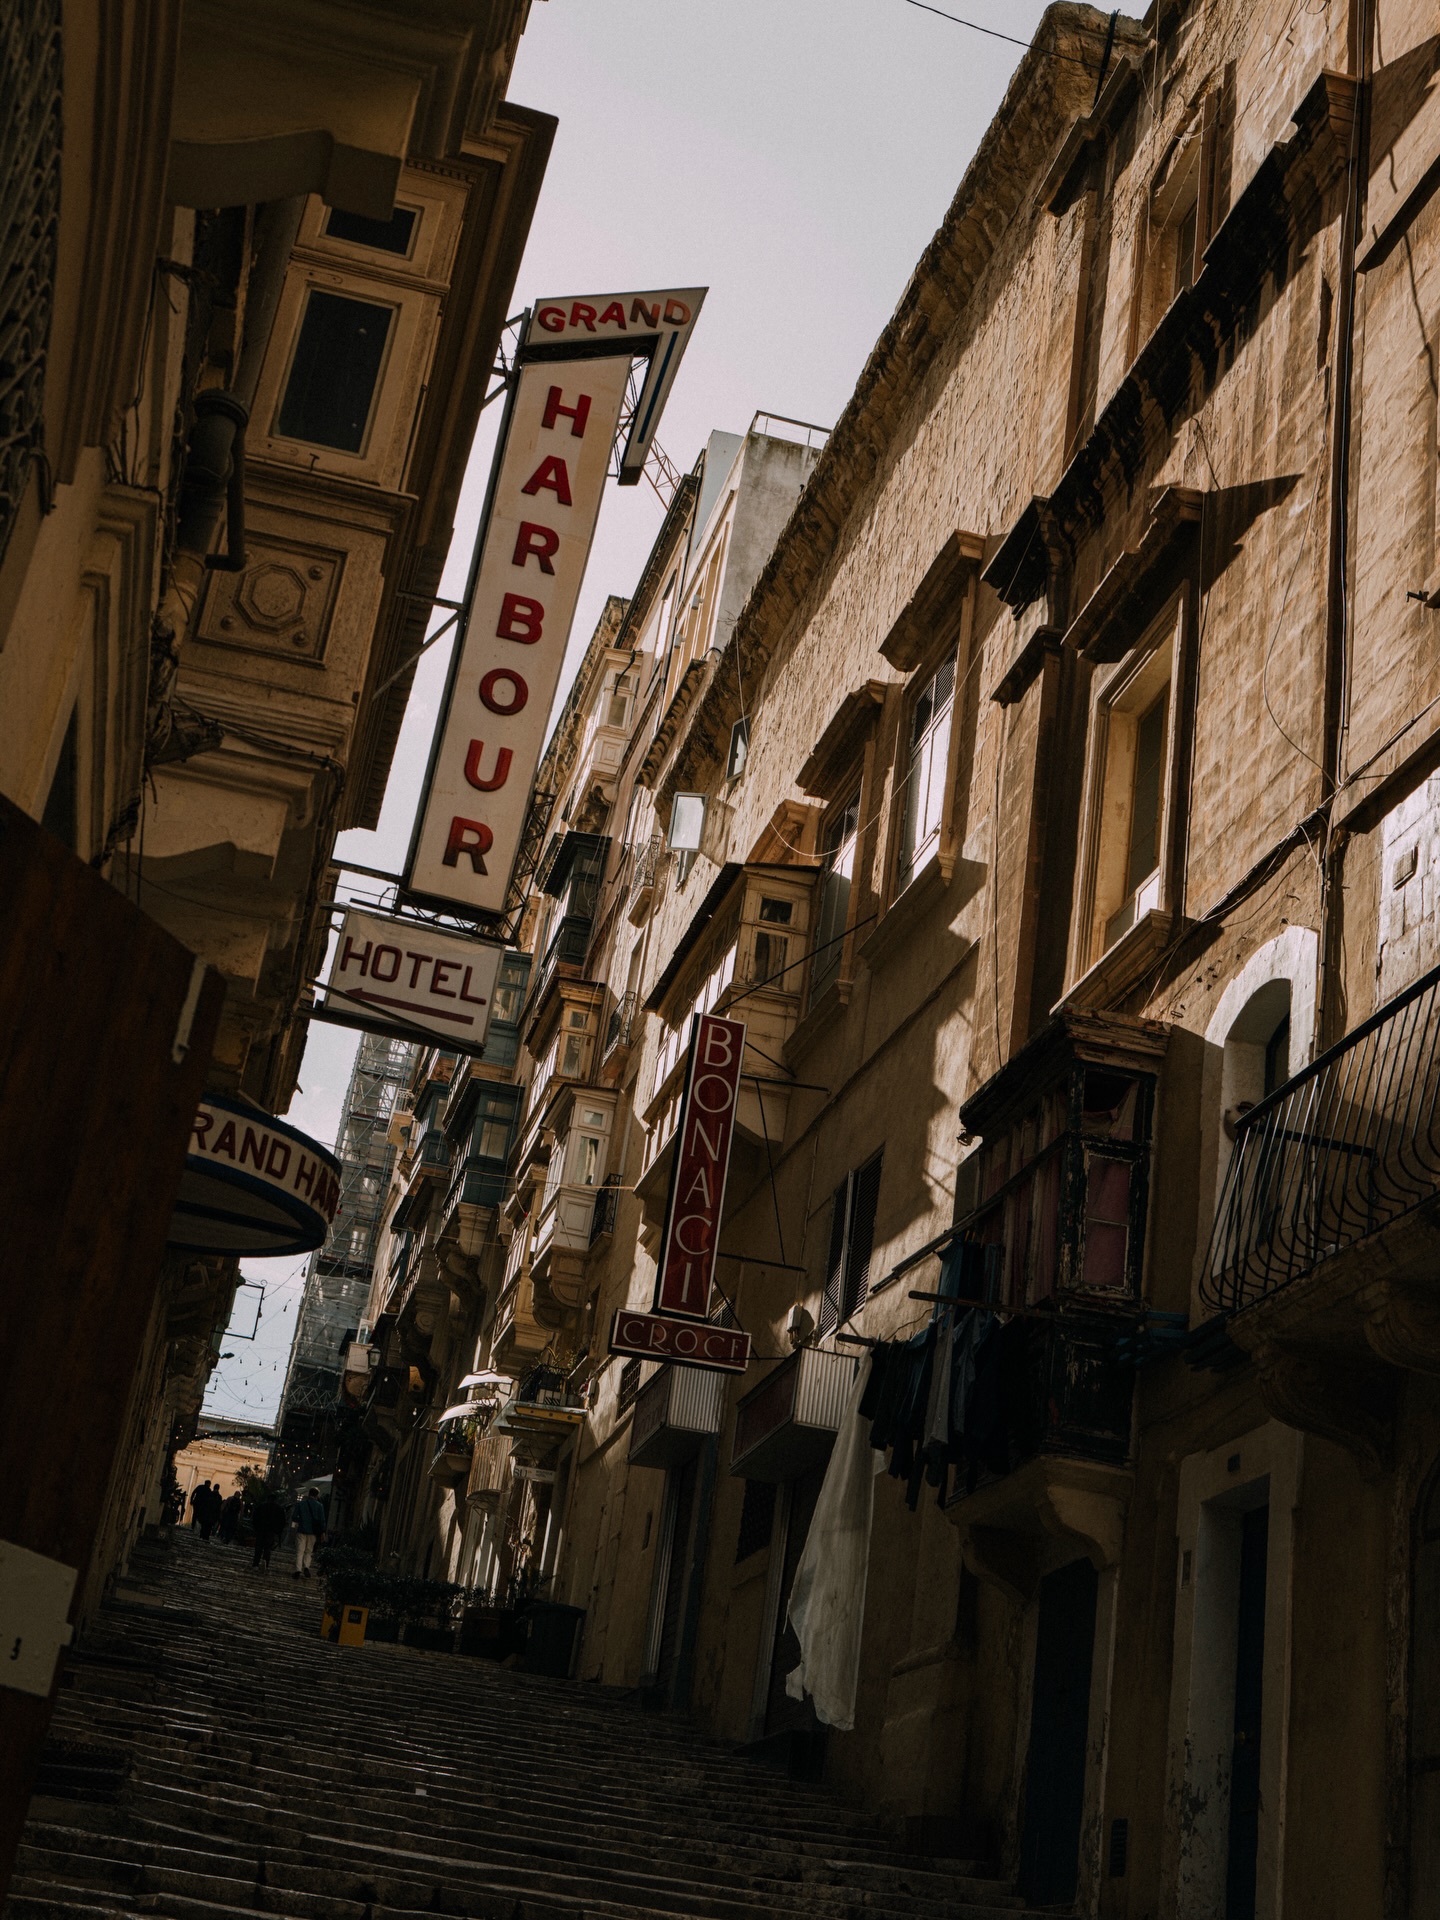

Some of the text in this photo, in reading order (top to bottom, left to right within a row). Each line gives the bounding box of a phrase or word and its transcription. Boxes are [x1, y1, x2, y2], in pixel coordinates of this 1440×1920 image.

[538, 298, 692, 332] GRAND
[442, 385, 592, 876] HARBOUR
[340, 936, 486, 1005] HOTEL
[675, 1023, 733, 1303] BONACI
[622, 1319, 743, 1364] CROCE
